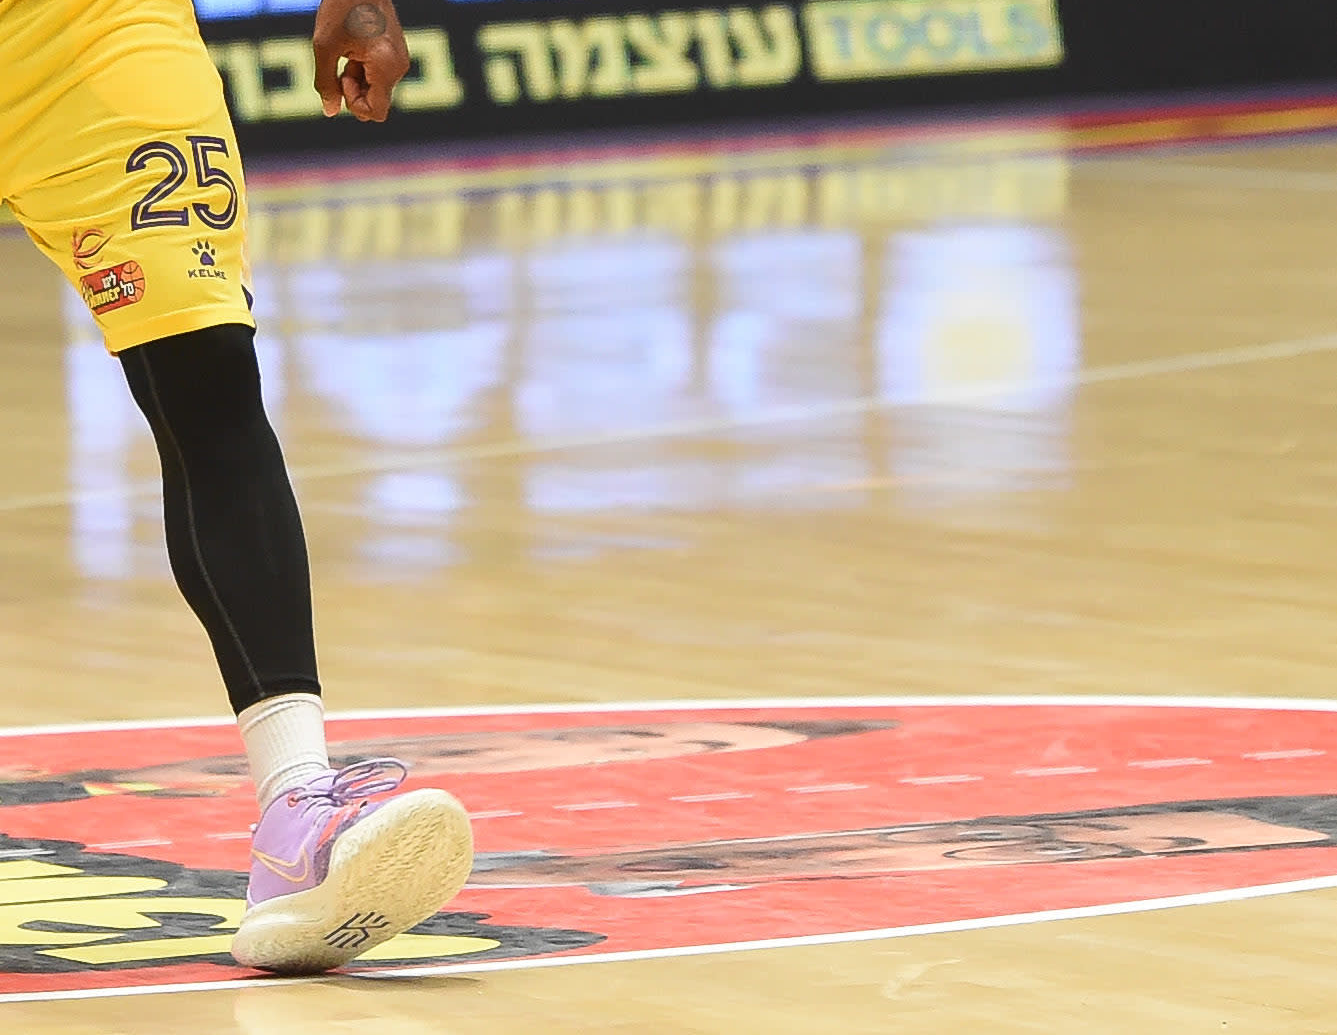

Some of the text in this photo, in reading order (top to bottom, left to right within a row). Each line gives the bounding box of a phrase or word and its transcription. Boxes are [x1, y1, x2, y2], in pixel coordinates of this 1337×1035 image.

[476, 2, 803, 105] עוצמה
[827, 1, 1052, 66] TOOLS
[125, 135, 238, 231] 25
